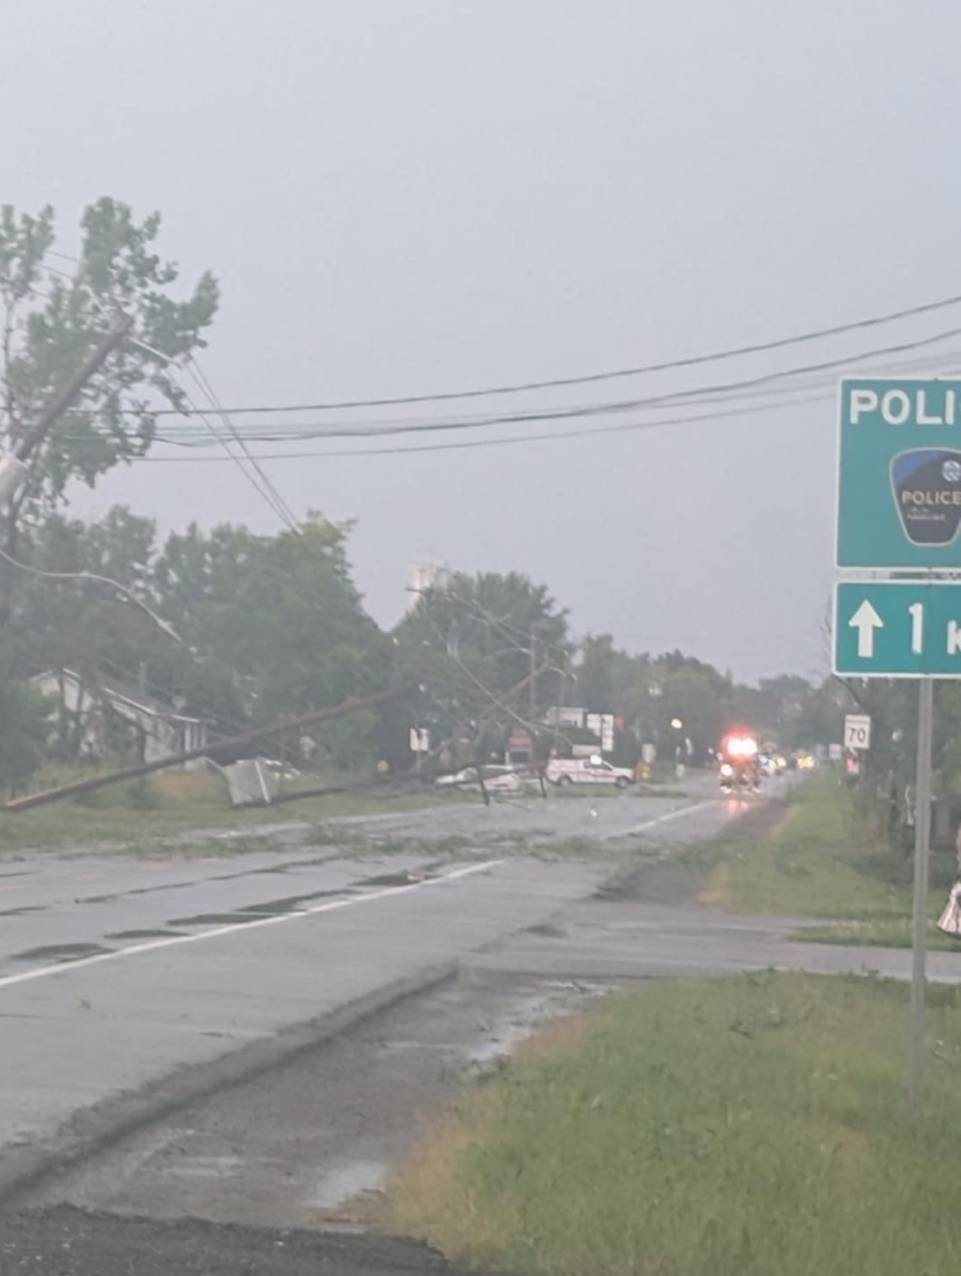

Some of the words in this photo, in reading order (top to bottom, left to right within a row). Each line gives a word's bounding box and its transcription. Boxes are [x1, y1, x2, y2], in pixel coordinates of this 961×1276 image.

[849, 389, 955, 425] POLI
[901, 490, 961, 506] POLICE
[908, 602, 923, 654] 1
[848, 727, 866, 743] 70
